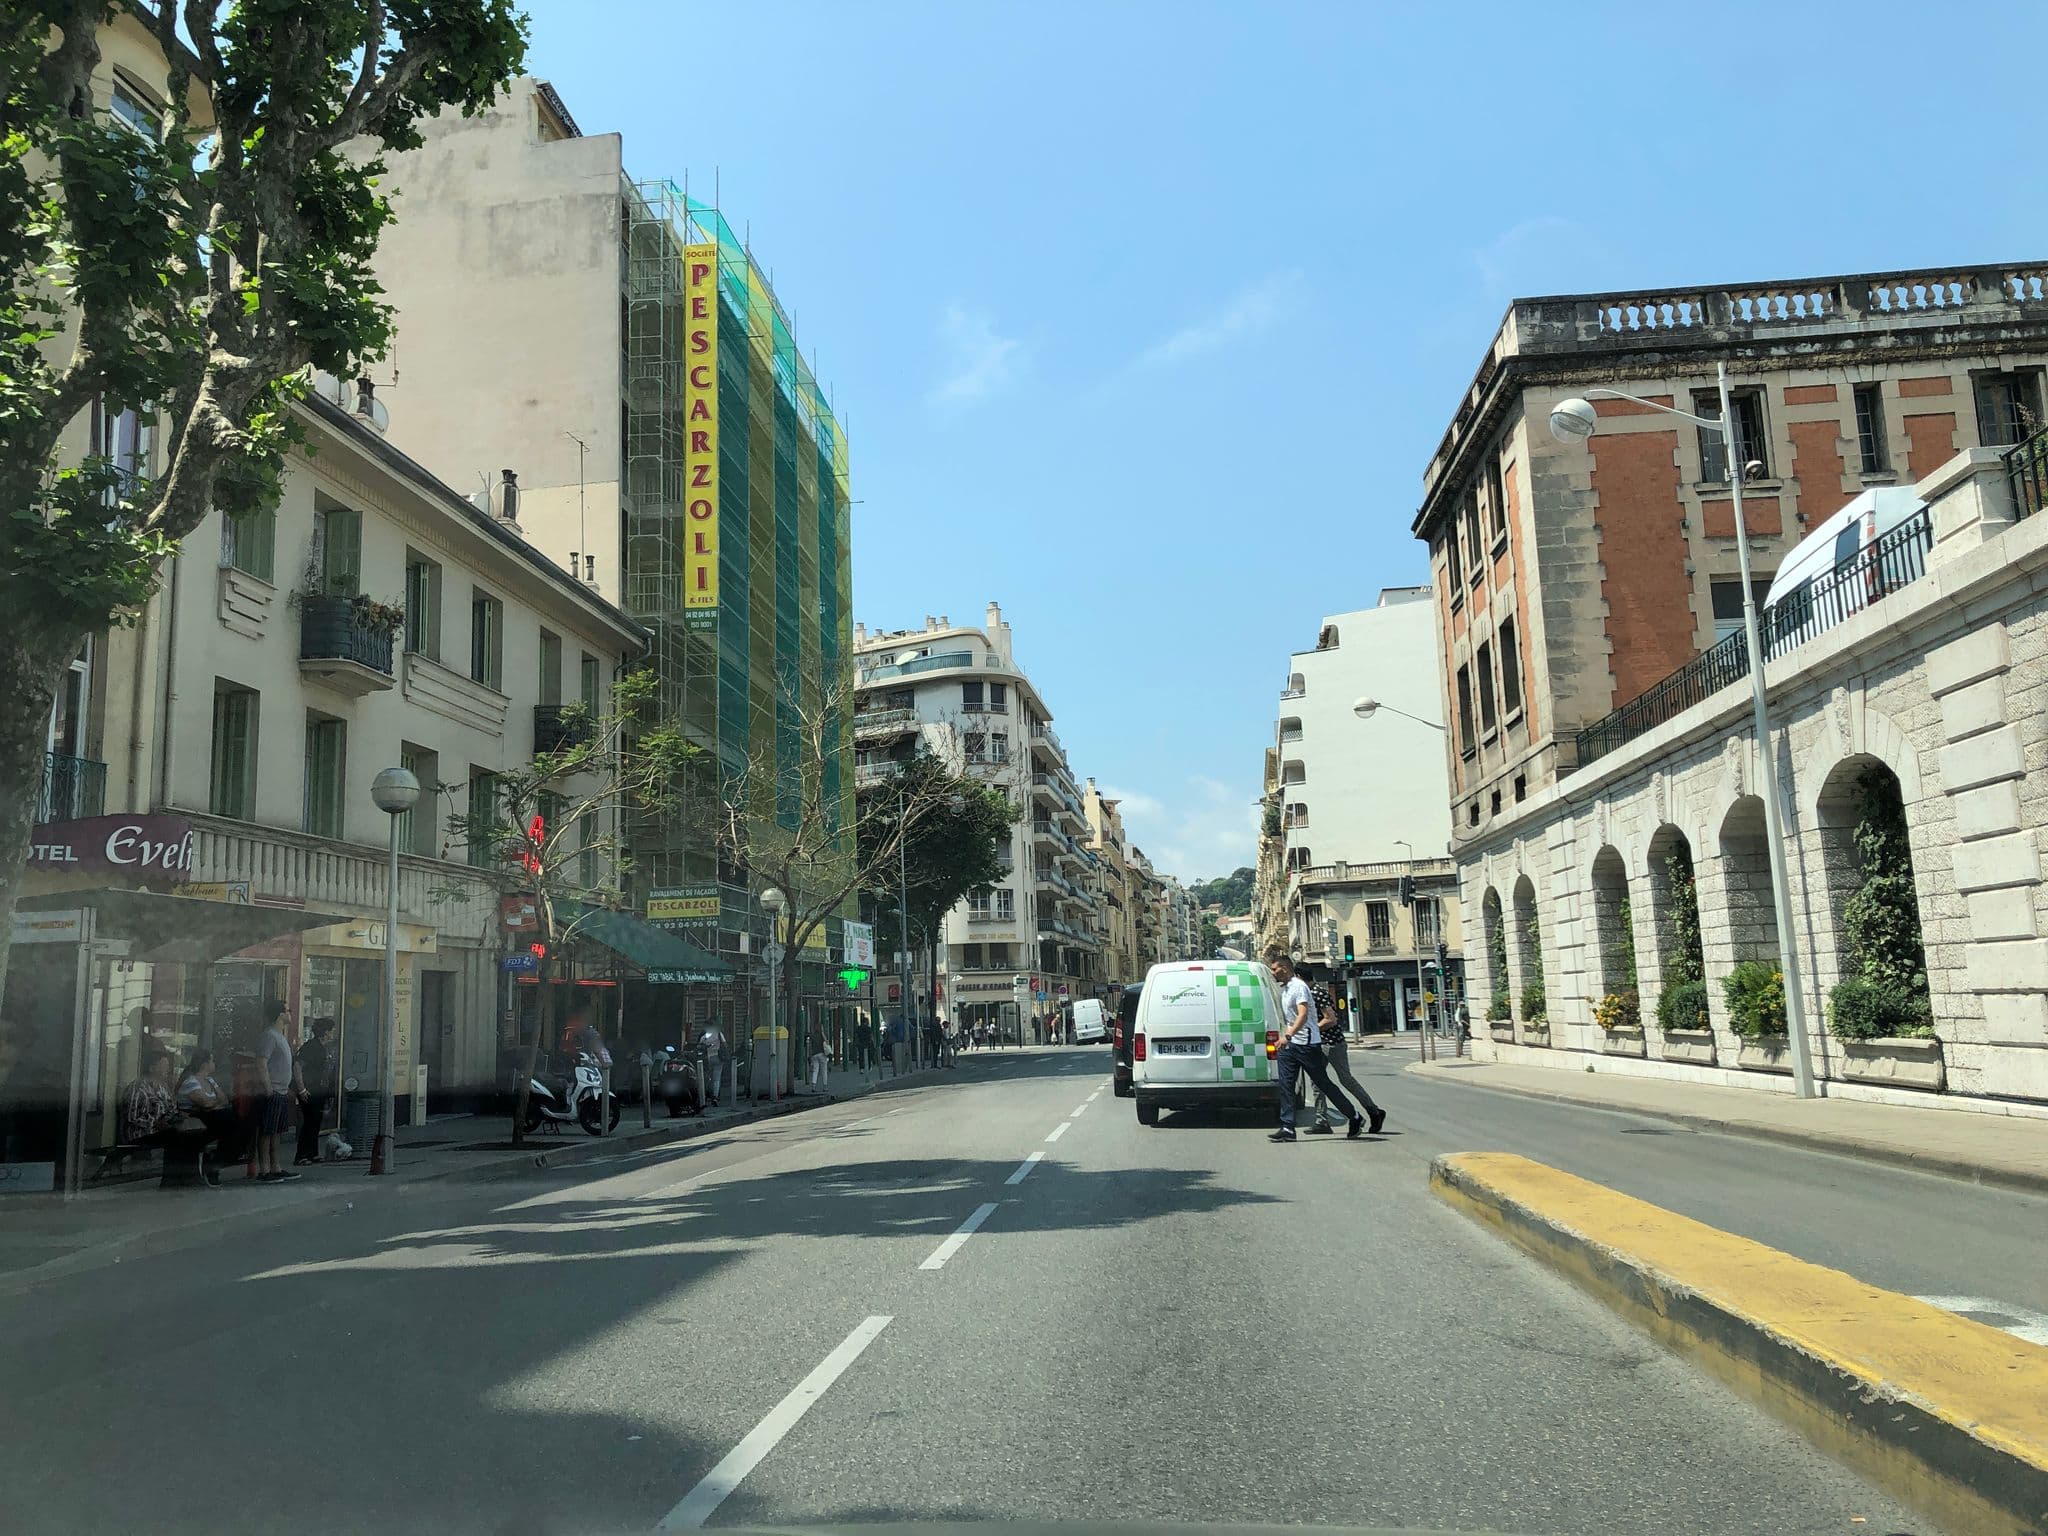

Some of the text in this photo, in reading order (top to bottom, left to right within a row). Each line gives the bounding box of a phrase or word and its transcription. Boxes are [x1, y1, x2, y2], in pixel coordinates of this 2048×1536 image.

[690, 264, 713, 590] PESCARZOLI
[27, 844, 78, 862] TEL
[650, 900, 717, 911] PESCARZOLI
